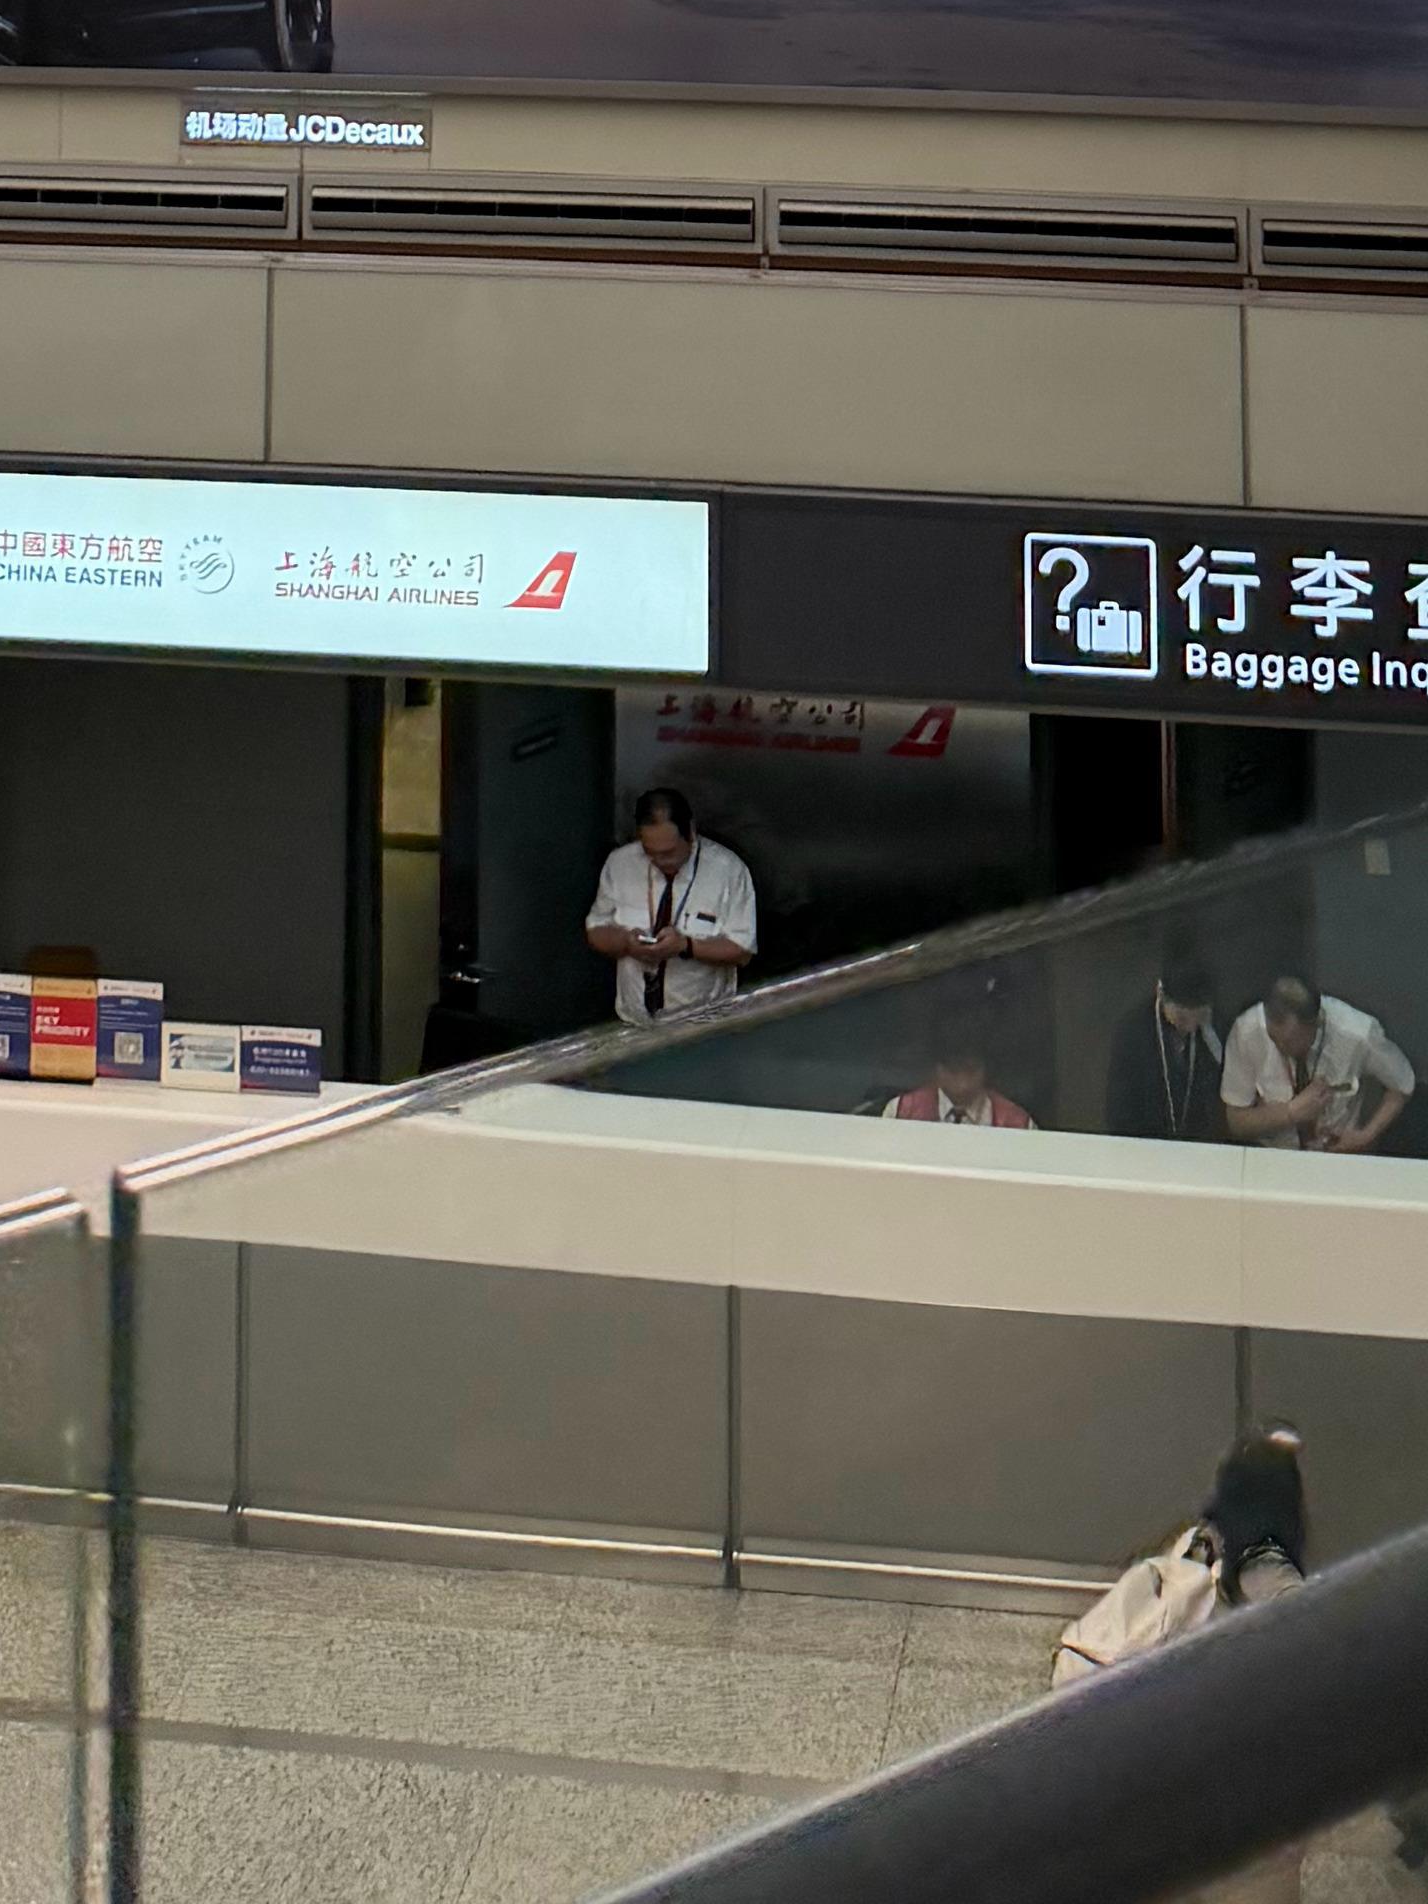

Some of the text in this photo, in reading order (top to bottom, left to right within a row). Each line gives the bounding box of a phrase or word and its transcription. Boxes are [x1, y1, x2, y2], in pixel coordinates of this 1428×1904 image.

[289, 114, 425, 146] JCDecaux
[64, 566, 164, 589] EASTERN
[274, 545, 484, 584] 上海航空公司
[274, 581, 480, 607] SHANGHAI AIRLINES
[1184, 642, 1361, 693] Baggage
